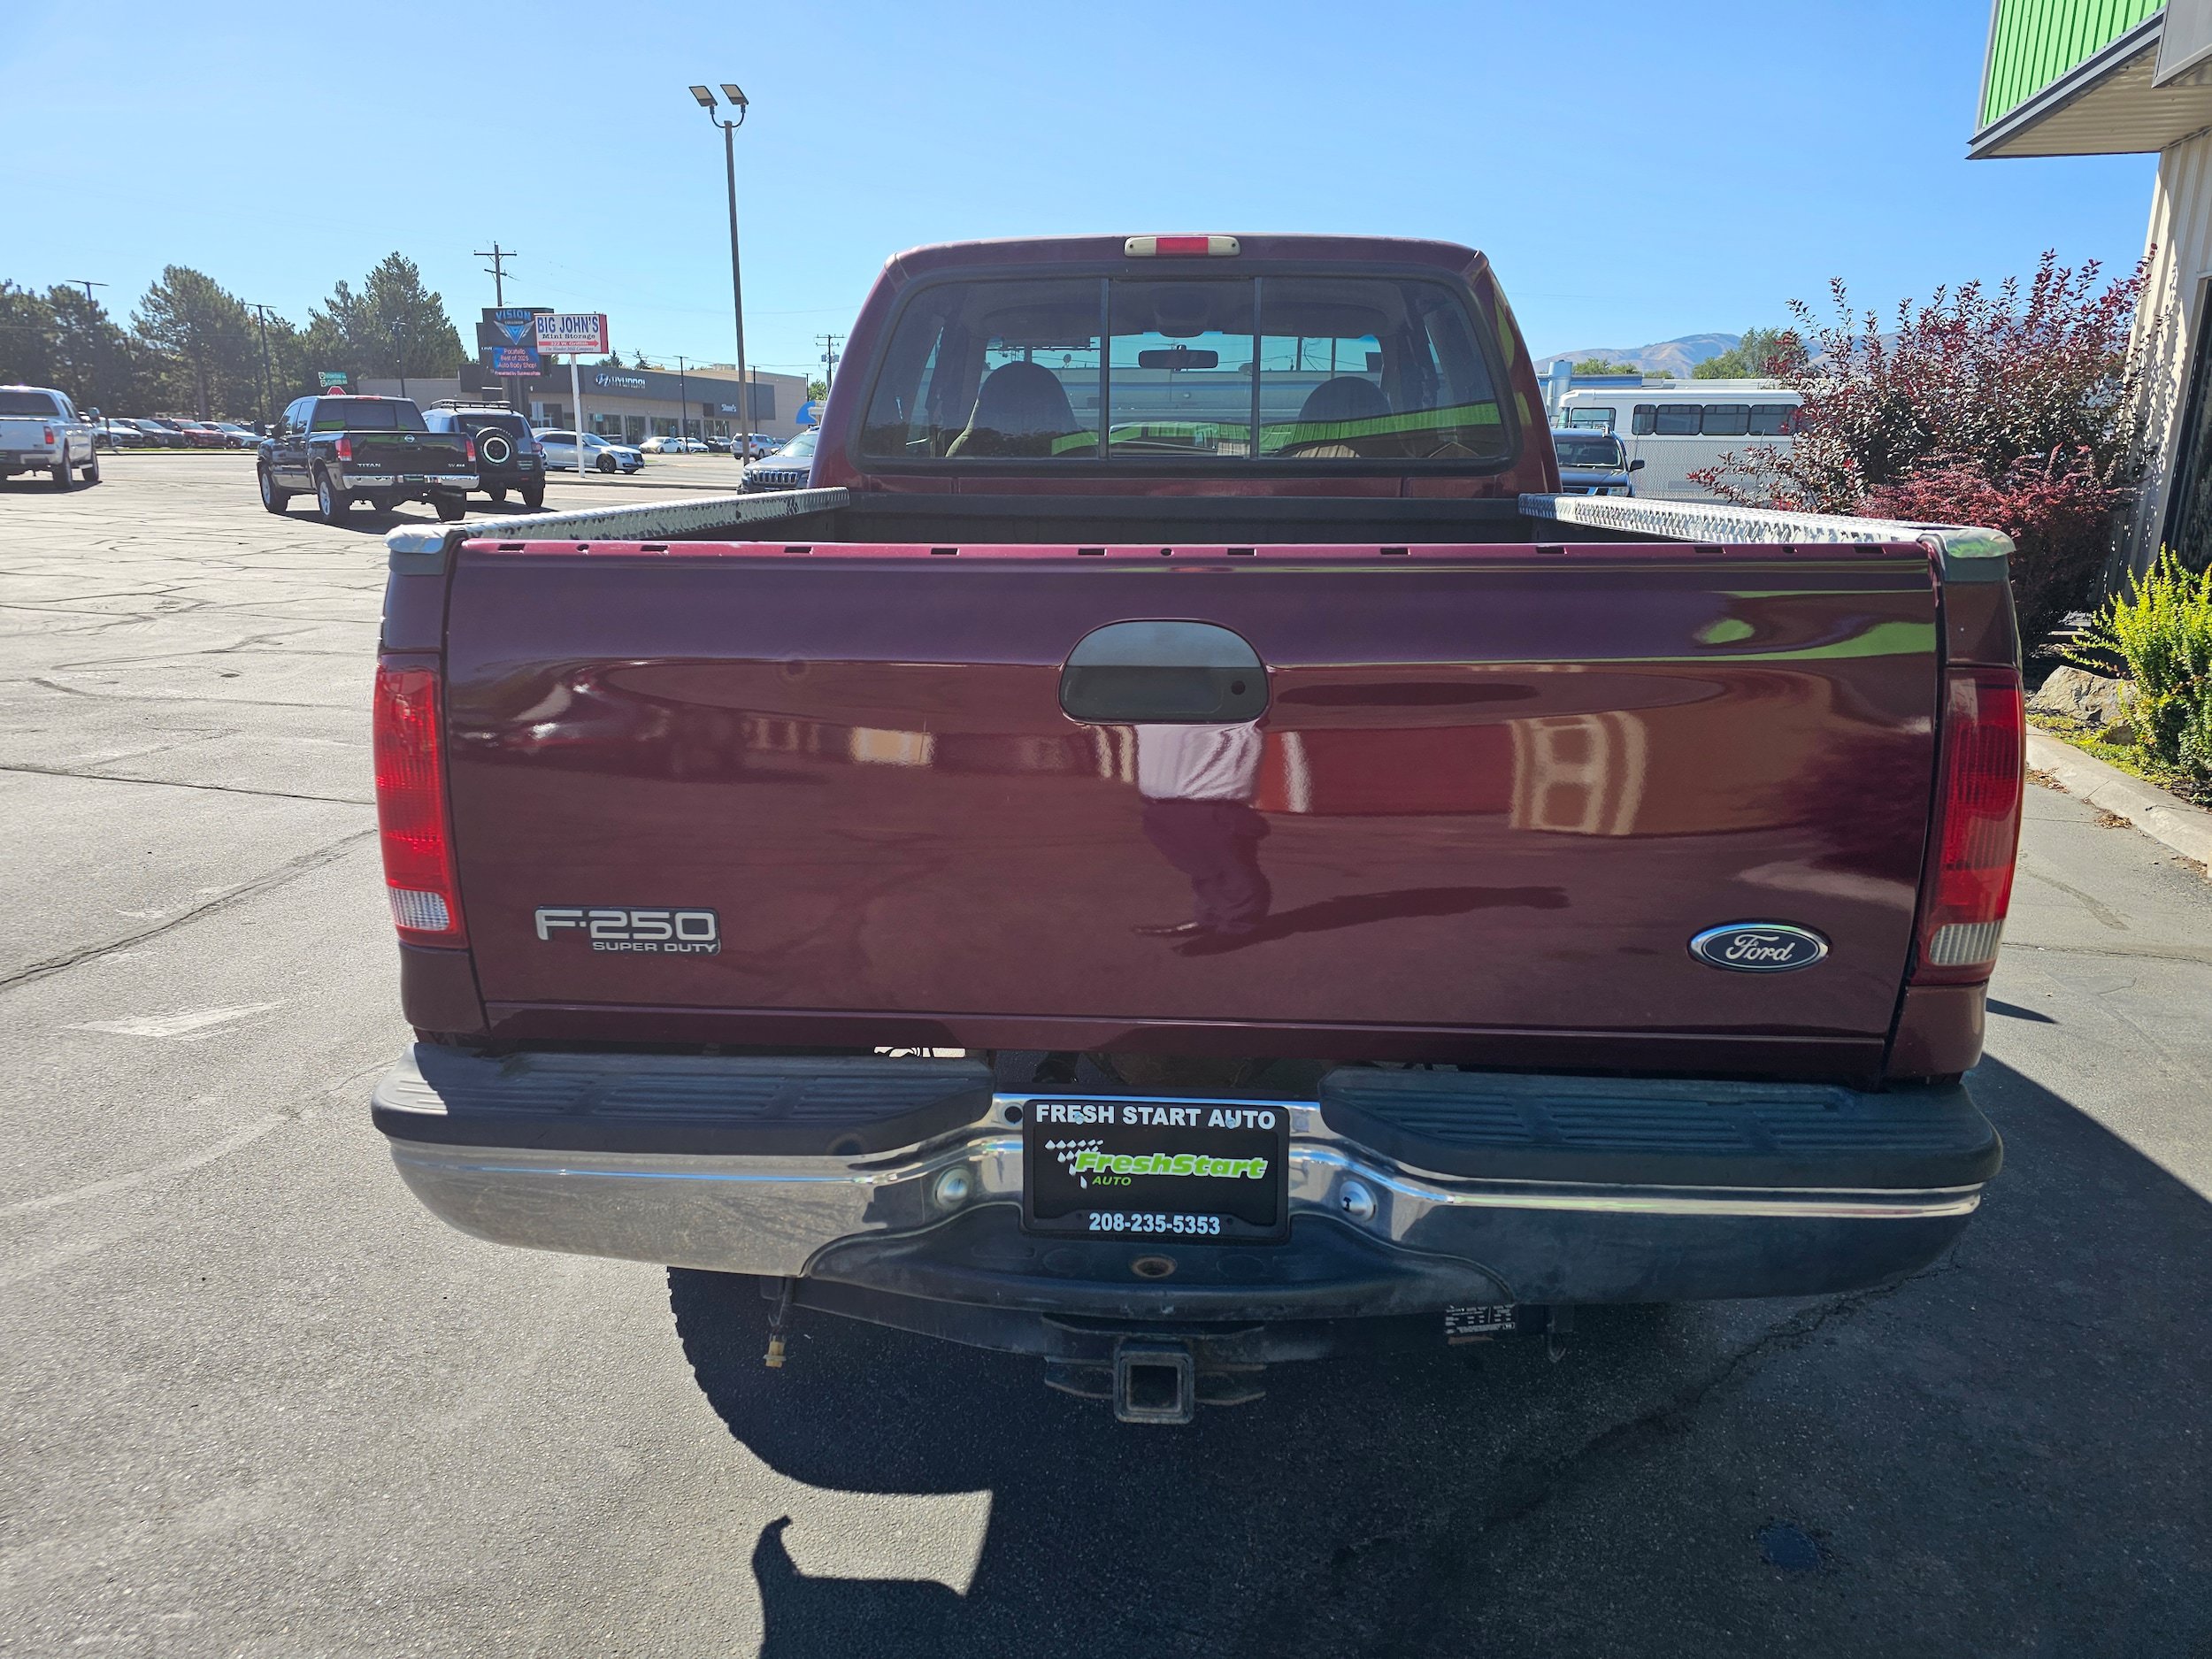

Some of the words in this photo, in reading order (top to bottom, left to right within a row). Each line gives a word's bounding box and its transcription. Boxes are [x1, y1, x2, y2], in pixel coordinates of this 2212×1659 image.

[495, 309, 531, 321] VISION
[537, 317, 556, 333] BIG
[559, 316, 599, 333] JOHN'S
[611, 375, 646, 388] HYUNDAI
[592, 941, 658, 951] SUPER
[664, 943, 717, 953] DUTY
[1725, 933, 1796, 962] Ford
[1035, 1104, 1115, 1125] FRESH
[1122, 1106, 1201, 1126] START
[1208, 1109, 1276, 1130] AUTO
[1074, 1152, 1268, 1179] FreshStart
[1092, 1176, 1132, 1187] AUTO
[1088, 1212, 1221, 1235] 208-235-5353
